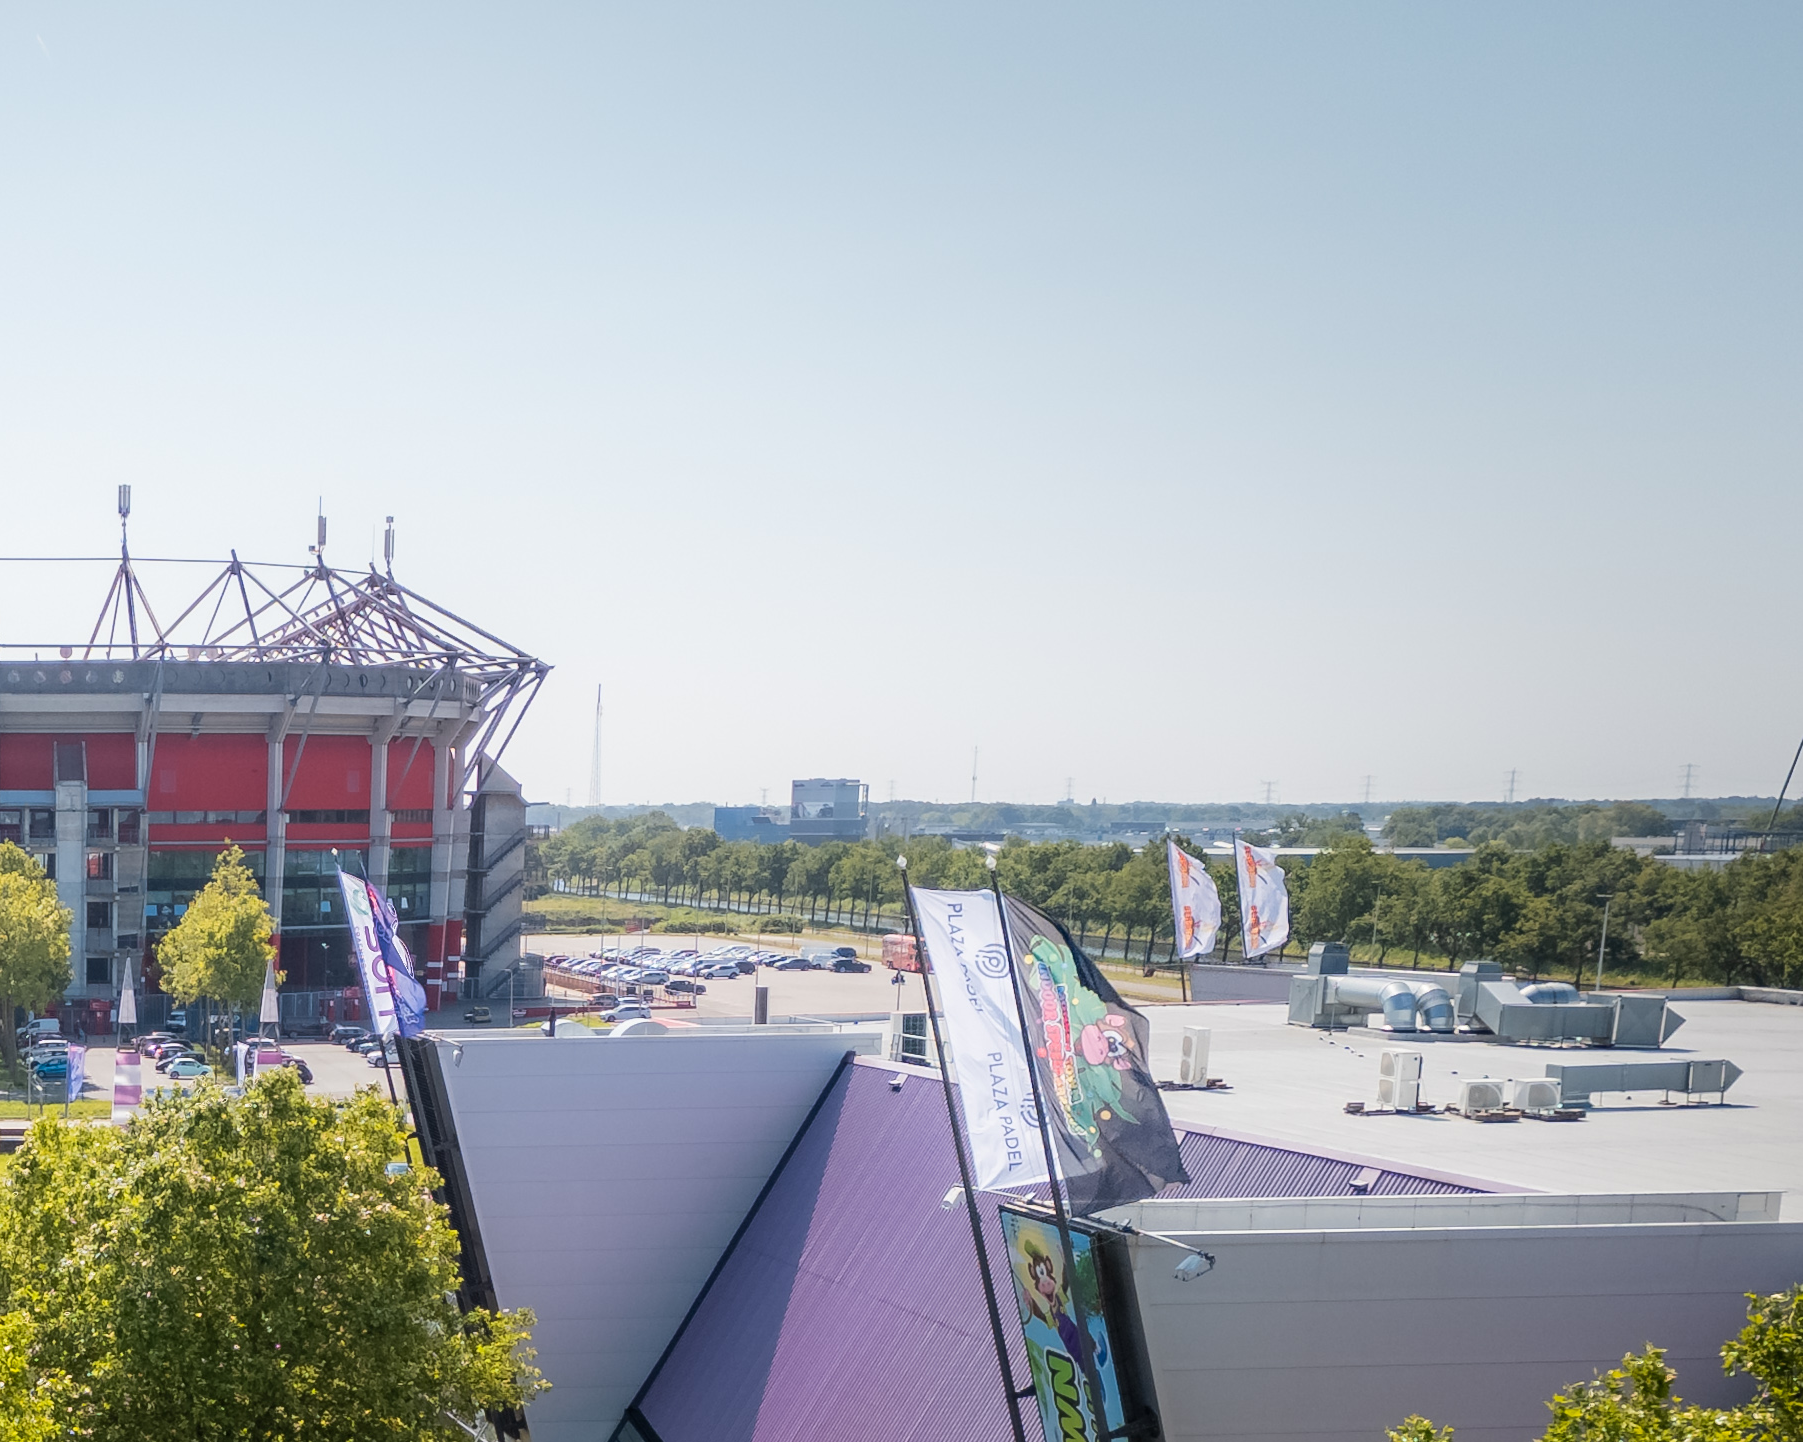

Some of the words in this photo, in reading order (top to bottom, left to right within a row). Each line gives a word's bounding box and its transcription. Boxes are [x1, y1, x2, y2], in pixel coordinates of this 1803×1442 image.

[1037, 962, 1059, 1022] INDOOR
[987, 1052, 1009, 1111] PLAZA
[999, 1116, 1023, 1172] PADEL
